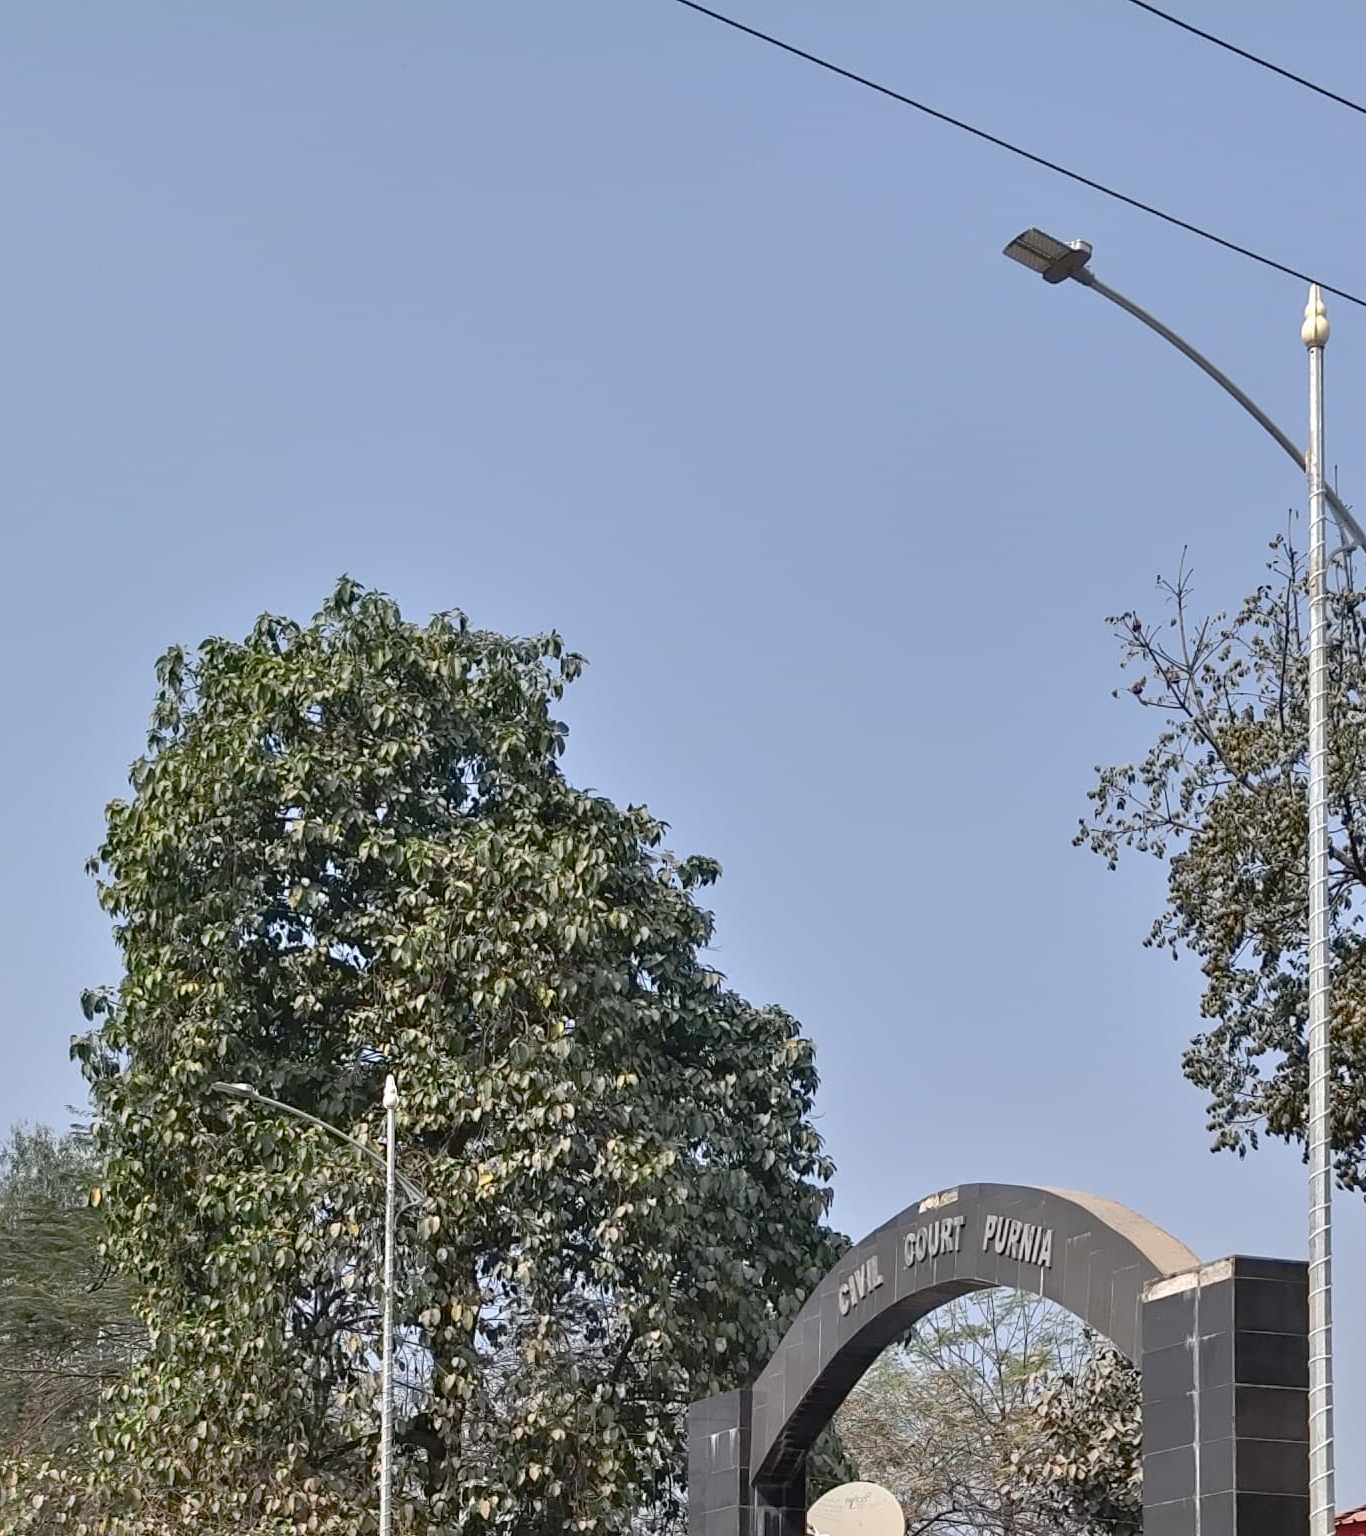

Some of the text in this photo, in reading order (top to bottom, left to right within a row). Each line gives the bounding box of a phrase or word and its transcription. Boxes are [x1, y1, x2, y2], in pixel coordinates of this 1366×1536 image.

[838, 1215, 1053, 1316] CIVIL COURT PURNIA
